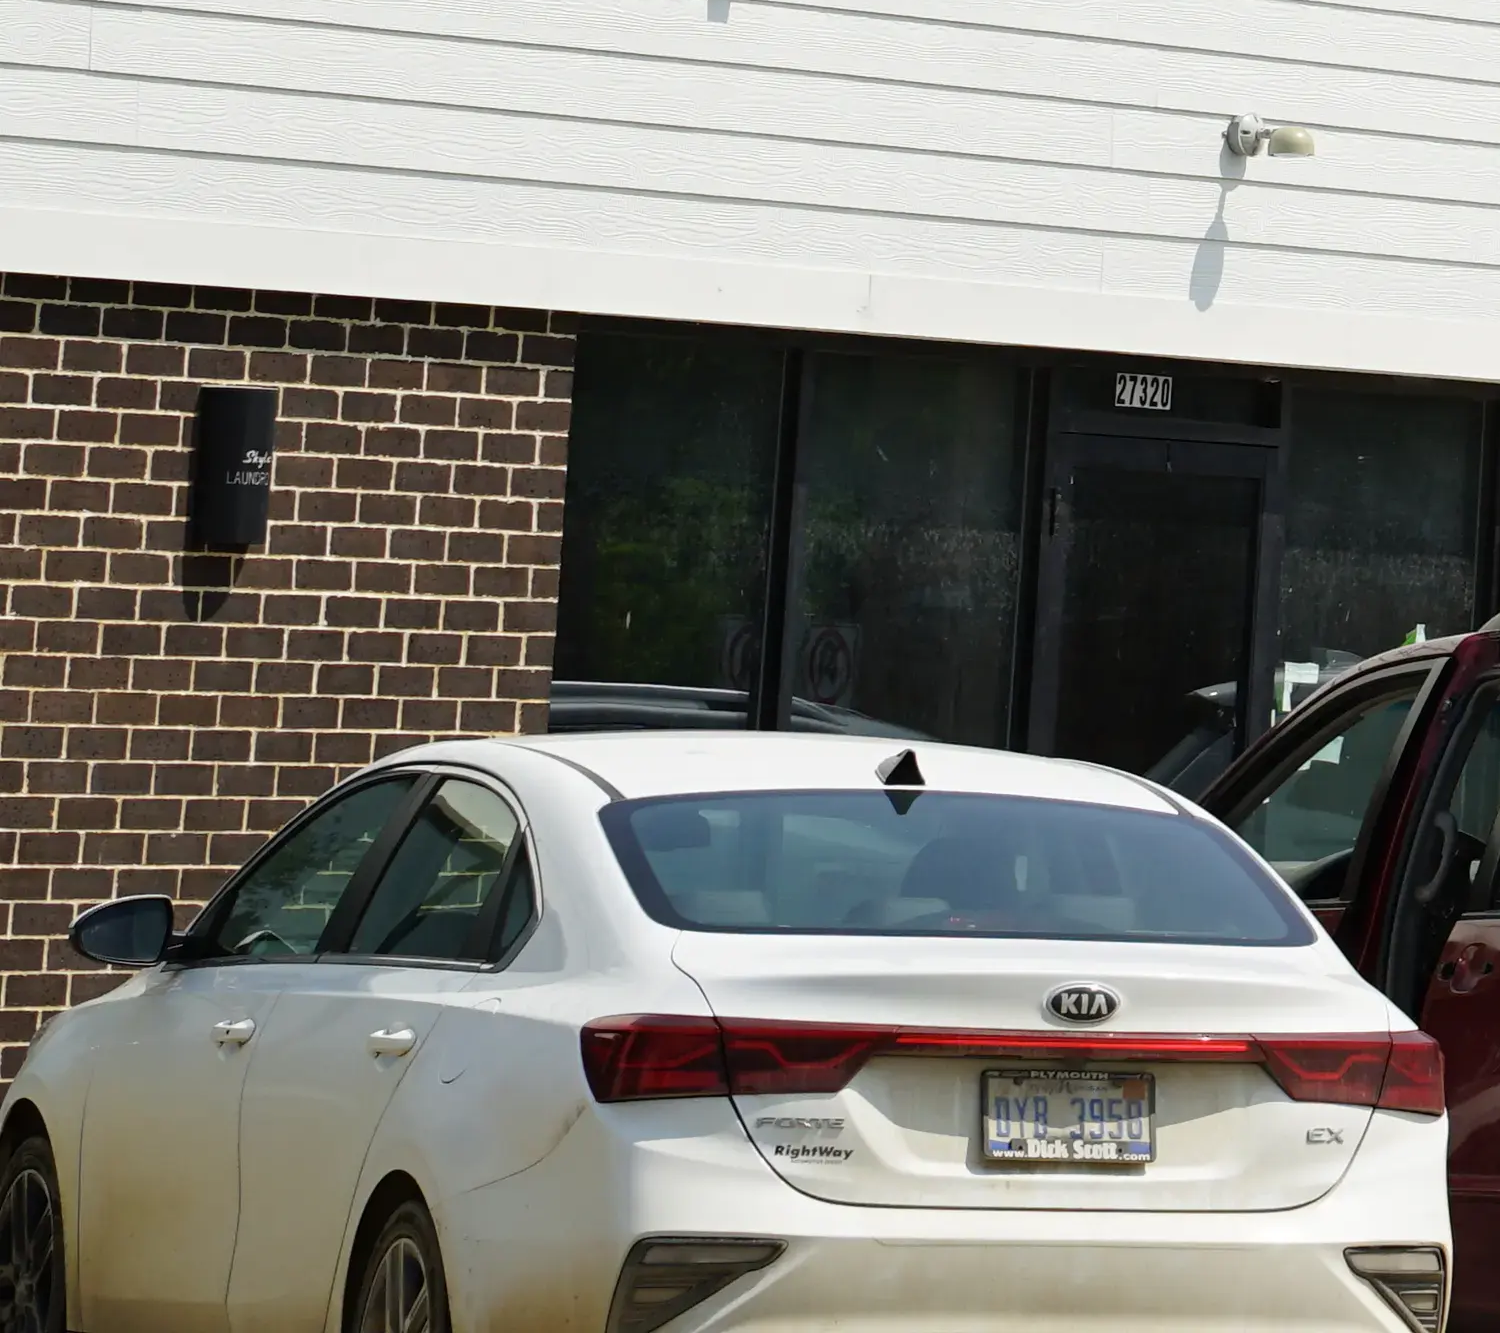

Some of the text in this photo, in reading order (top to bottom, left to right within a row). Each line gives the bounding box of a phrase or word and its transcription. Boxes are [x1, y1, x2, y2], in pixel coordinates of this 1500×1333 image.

[1116, 374, 1170, 408] 27320
[1060, 992, 1108, 1015] KIA
[1030, 1071, 1109, 1081] PLYMOUTH
[1069, 1097, 1143, 1140] 3958
[1306, 1128, 1344, 1144] EX
[774, 1145, 854, 1160] RightWay
